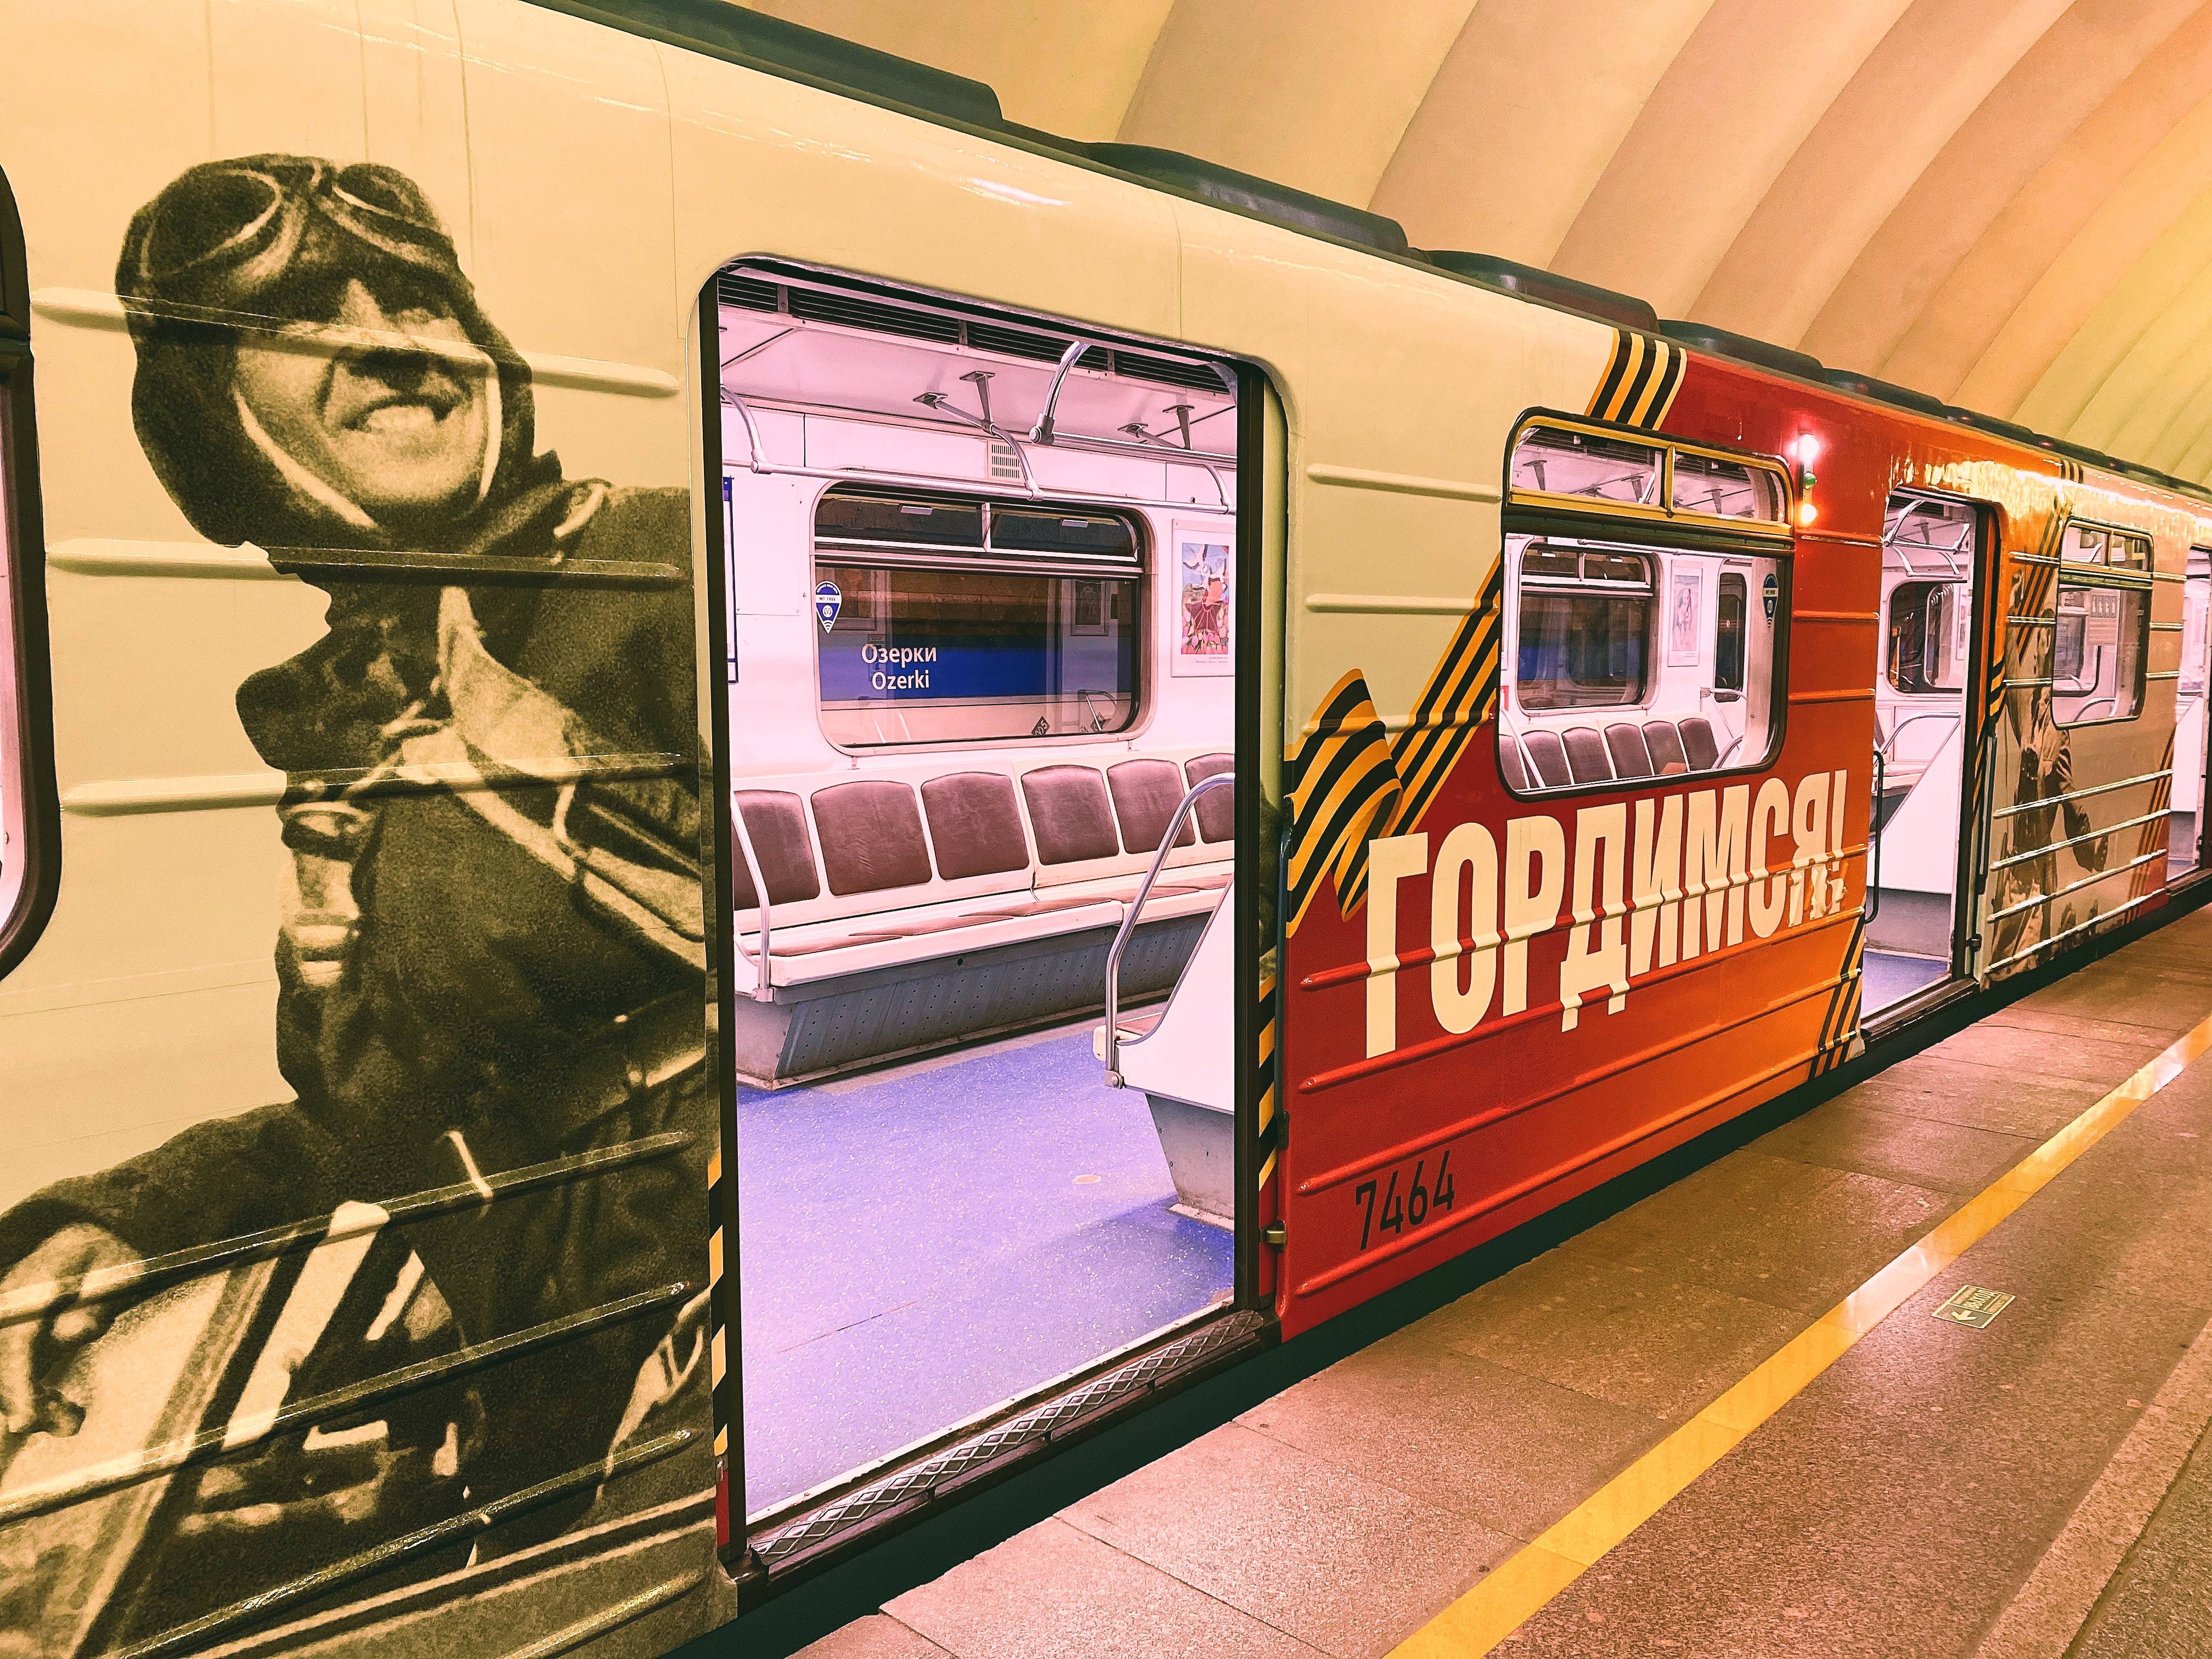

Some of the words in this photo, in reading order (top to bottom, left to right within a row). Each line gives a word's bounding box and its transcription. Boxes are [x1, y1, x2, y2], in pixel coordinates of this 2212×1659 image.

[861, 644, 936, 668] Озерки
[872, 669, 929, 690] Ozerki
[1365, 769, 1849, 1059] ГОРДИМСЯ!
[1355, 1150, 1455, 1251] 7464
[1962, 1289, 1999, 1310] ВЫХОД
